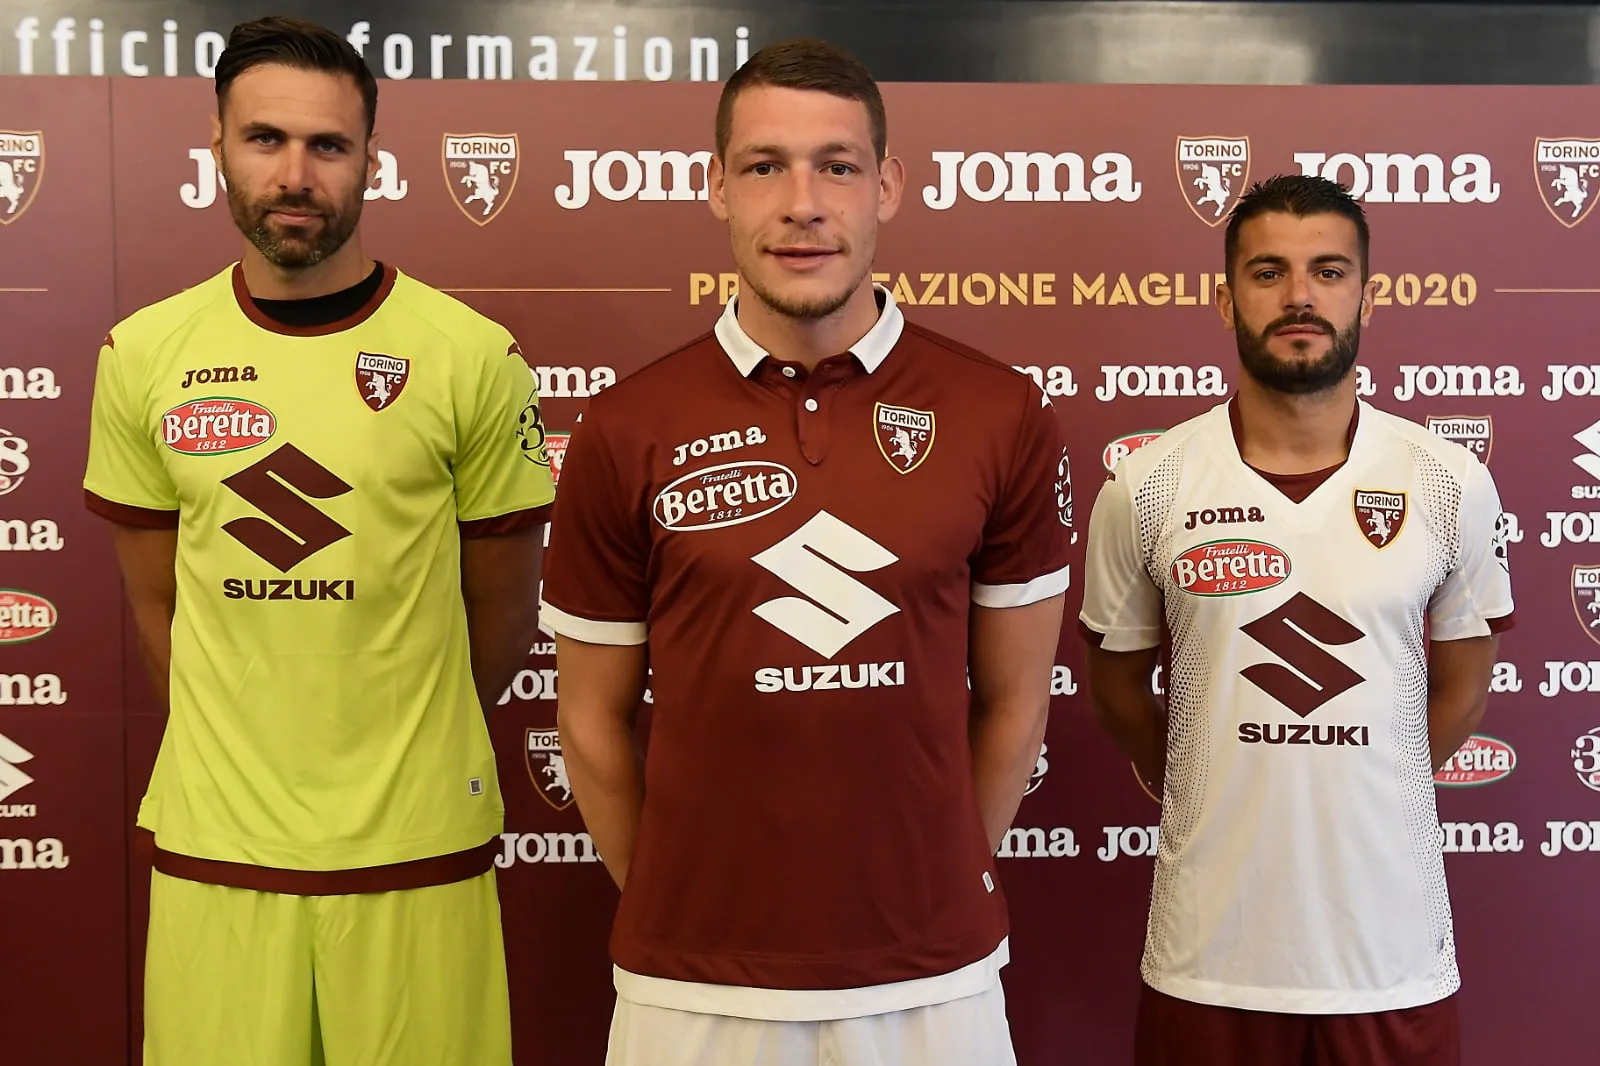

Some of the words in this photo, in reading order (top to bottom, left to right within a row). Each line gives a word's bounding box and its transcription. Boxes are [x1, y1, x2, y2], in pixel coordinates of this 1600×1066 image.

[15, 17, 225, 77] fficio
[347, 21, 750, 82] formazioni
[450, 142, 511, 155] TORINO
[1183, 144, 1242, 157] TORINO
[1543, 145, 1600, 158] TORINO
[13, 159, 36, 172] FC
[489, 161, 511, 175] FC
[1221, 163, 1242, 176] FC
[1579, 164, 1600, 178] FC
[554, 150, 713, 209] Jom
[362, 356, 403, 371] TORINO
[386, 373, 401, 384] FC
[190, 403, 236, 415] Fratelli
[882, 410, 927, 427] TORINO
[163, 409, 273, 445] Beretta
[1433, 423, 1485, 435] TORINO
[911, 429, 927, 441] FC
[194, 439, 227, 451] 1812
[699, 469, 742, 485] Fratelli
[659, 471, 793, 527] Beretta
[1360, 494, 1400, 507] TORINO
[708, 508, 743, 522] 1812
[1385, 510, 1400, 520] FC
[1202, 544, 1249, 558] Fratelli
[1174, 551, 1288, 588] Beretta
[223, 578, 354, 601] SUZUKI
[1214, 580, 1247, 592] 1812
[754, 661, 905, 693] SUZUKI
[532, 736, 560, 747] TOR
[1238, 723, 1369, 746] SUZUKI
[494, 832, 603, 869] Jom
